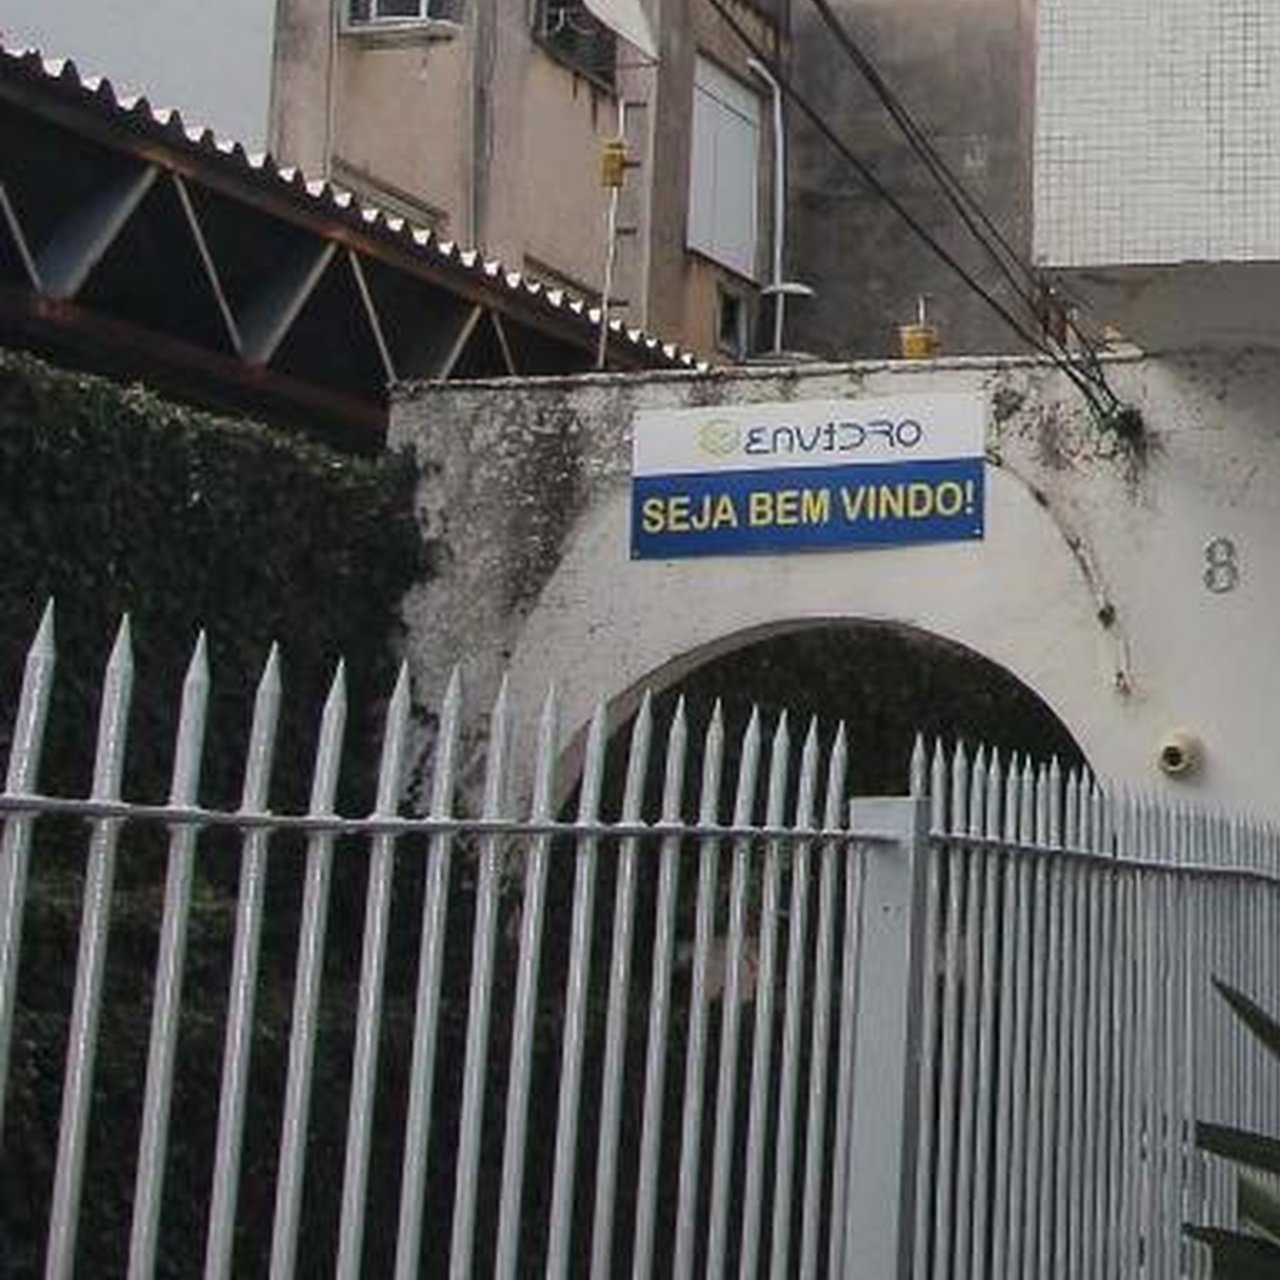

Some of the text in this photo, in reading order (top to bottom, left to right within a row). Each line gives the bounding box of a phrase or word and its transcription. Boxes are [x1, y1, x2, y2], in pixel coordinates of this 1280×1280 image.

[642, 478, 975, 533] SEJA BEM VINDO!
